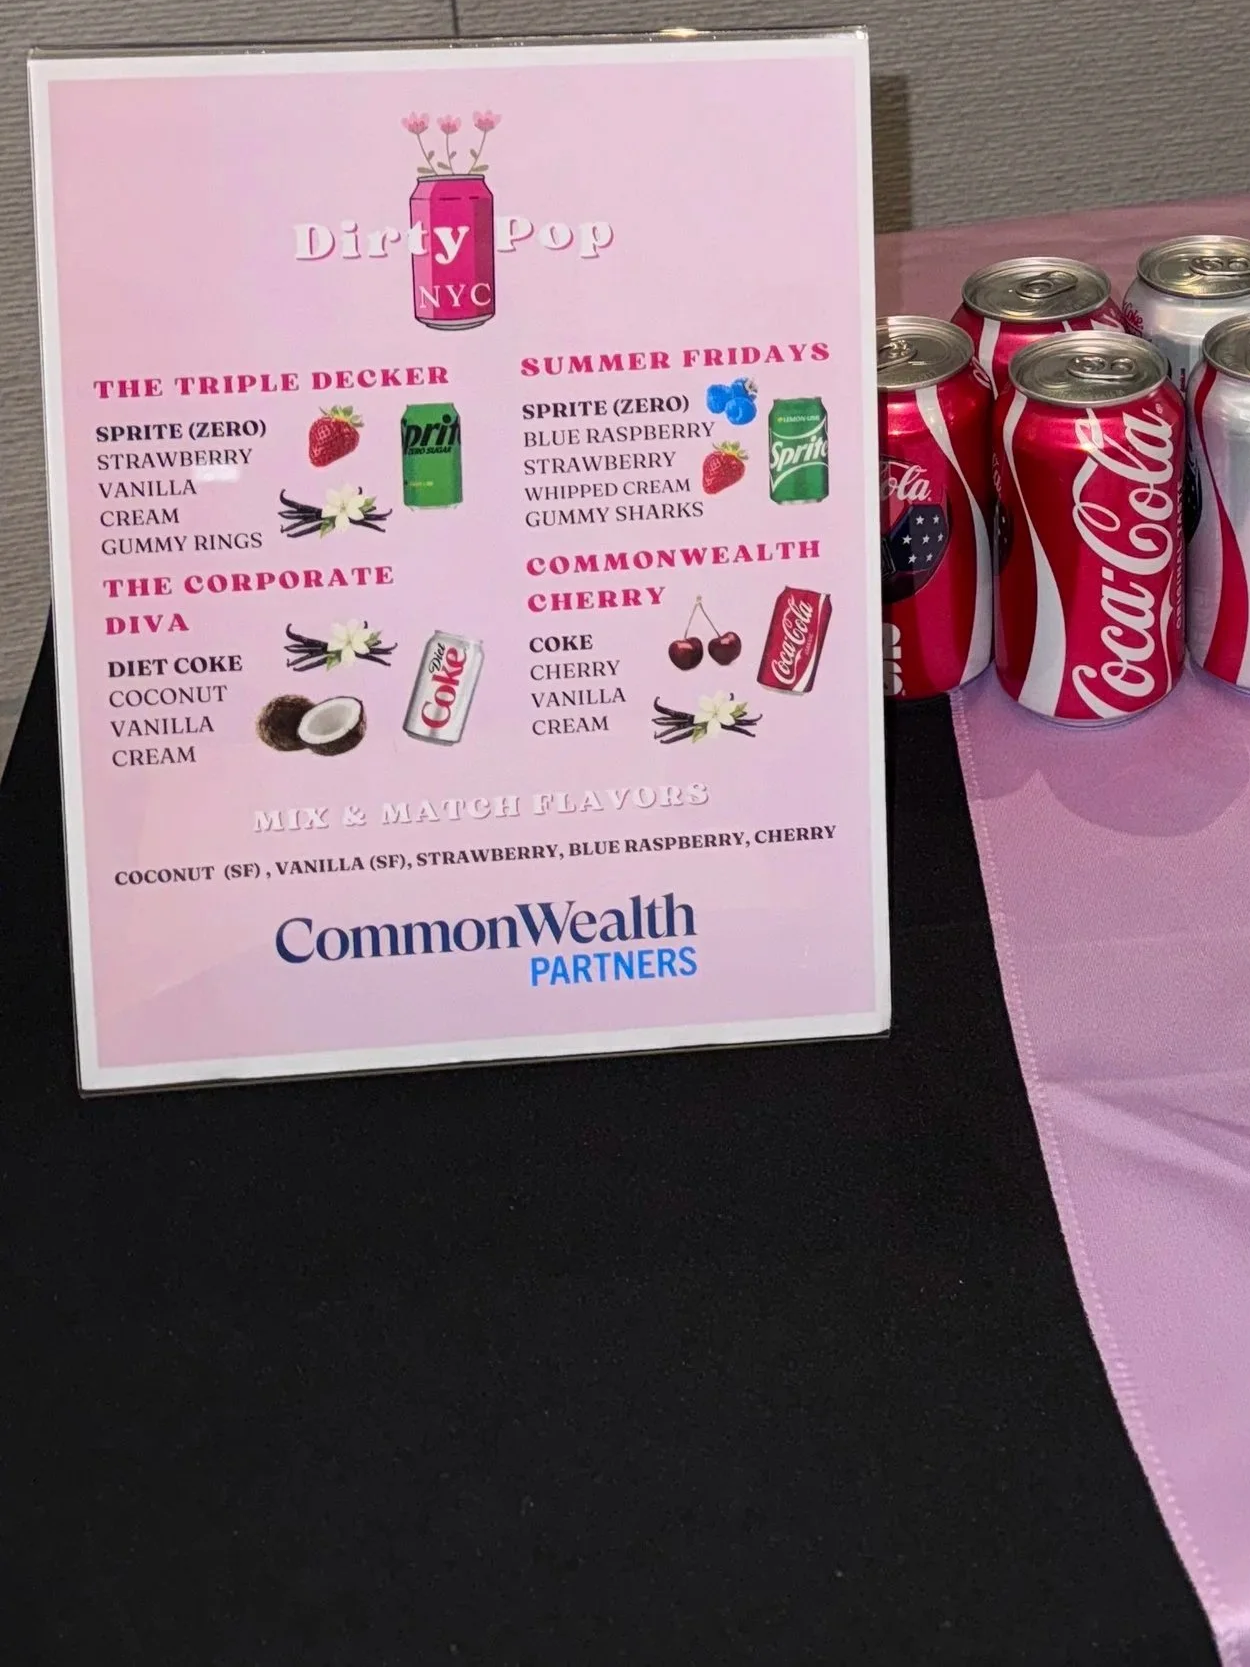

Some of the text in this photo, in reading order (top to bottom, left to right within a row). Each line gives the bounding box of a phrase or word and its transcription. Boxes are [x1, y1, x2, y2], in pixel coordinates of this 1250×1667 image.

[293, 215, 614, 265] Dirty Pop
[419, 283, 491, 309] NYC
[521, 342, 830, 377] SUMMER FRIDAYS
[93, 366, 450, 399] THE TRIPLE DECKER
[522, 395, 690, 420] SPRITE (ZERO)
[96, 419, 266, 443] SPRITE (ZERO)
[524, 422, 715, 448] BLUE RASPBERRY
[97, 448, 252, 471] STRAWBERRY
[524, 452, 676, 475] STRAWBERRY
[99, 479, 197, 499] VANILLA
[525, 478, 691, 501] WHIPPED CREAM
[100, 508, 180, 527] CREAM
[525, 502, 704, 528] GUMMY SHARKS
[101, 532, 263, 555] GUMMY RINGS
[526, 540, 820, 576] COMMONWEALTH
[103, 566, 395, 598] THE CORPORATE
[527, 586, 666, 613] CHERRY
[106, 613, 189, 635] DIVA
[529, 634, 593, 653] COKE
[108, 655, 243, 678] DIET COKE
[428, 642, 446, 674] Diet
[530, 660, 620, 681] CHERRY
[109, 685, 228, 708] COCONUT
[421, 646, 469, 729] Coke
[531, 687, 626, 708] VANILLA
[111, 715, 214, 737] VANILLA
[532, 716, 609, 736] CREAM
[112, 746, 196, 767] CREAM
[253, 782, 711, 833] MIX & MATCH FLAVORS
[115, 865, 214, 886] COCONUT
[276, 856, 365, 876] VANILLA
[369, 853, 412, 871] (SF),
[416, 843, 565, 867] STRAWBERRY,
[569, 839, 620, 857] BLUE
[624, 831, 751, 854] RASPBERRY,
[754, 825, 837, 844] CHERRY
[276, 892, 699, 963] CommonWealth
[530, 946, 697, 987] PARTNERS
